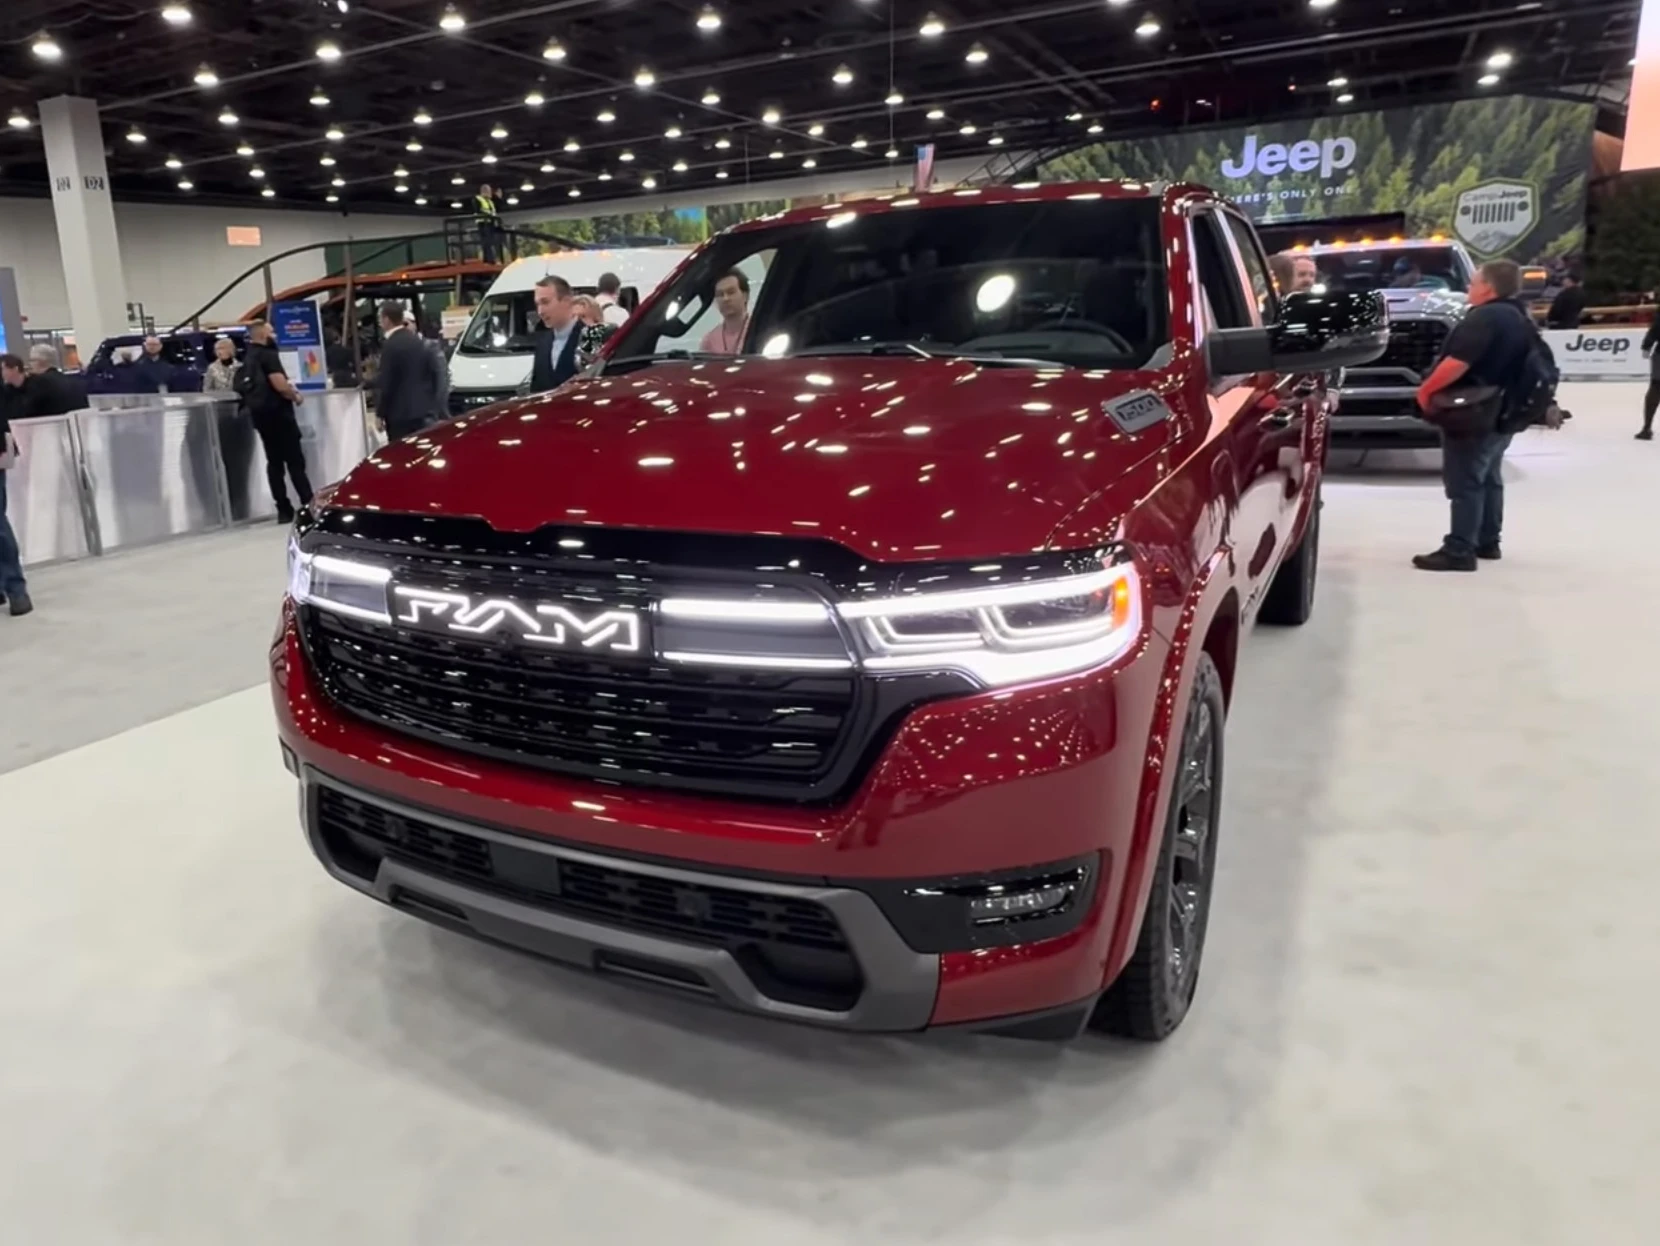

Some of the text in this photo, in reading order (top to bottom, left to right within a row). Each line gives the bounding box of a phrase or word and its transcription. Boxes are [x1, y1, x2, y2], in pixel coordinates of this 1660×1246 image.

[1221, 135, 1357, 178] Jeep
[1280, 188, 1317, 200] ONLY
[1565, 334, 1630, 355] Jeep
[394, 586, 640, 651] RAM
